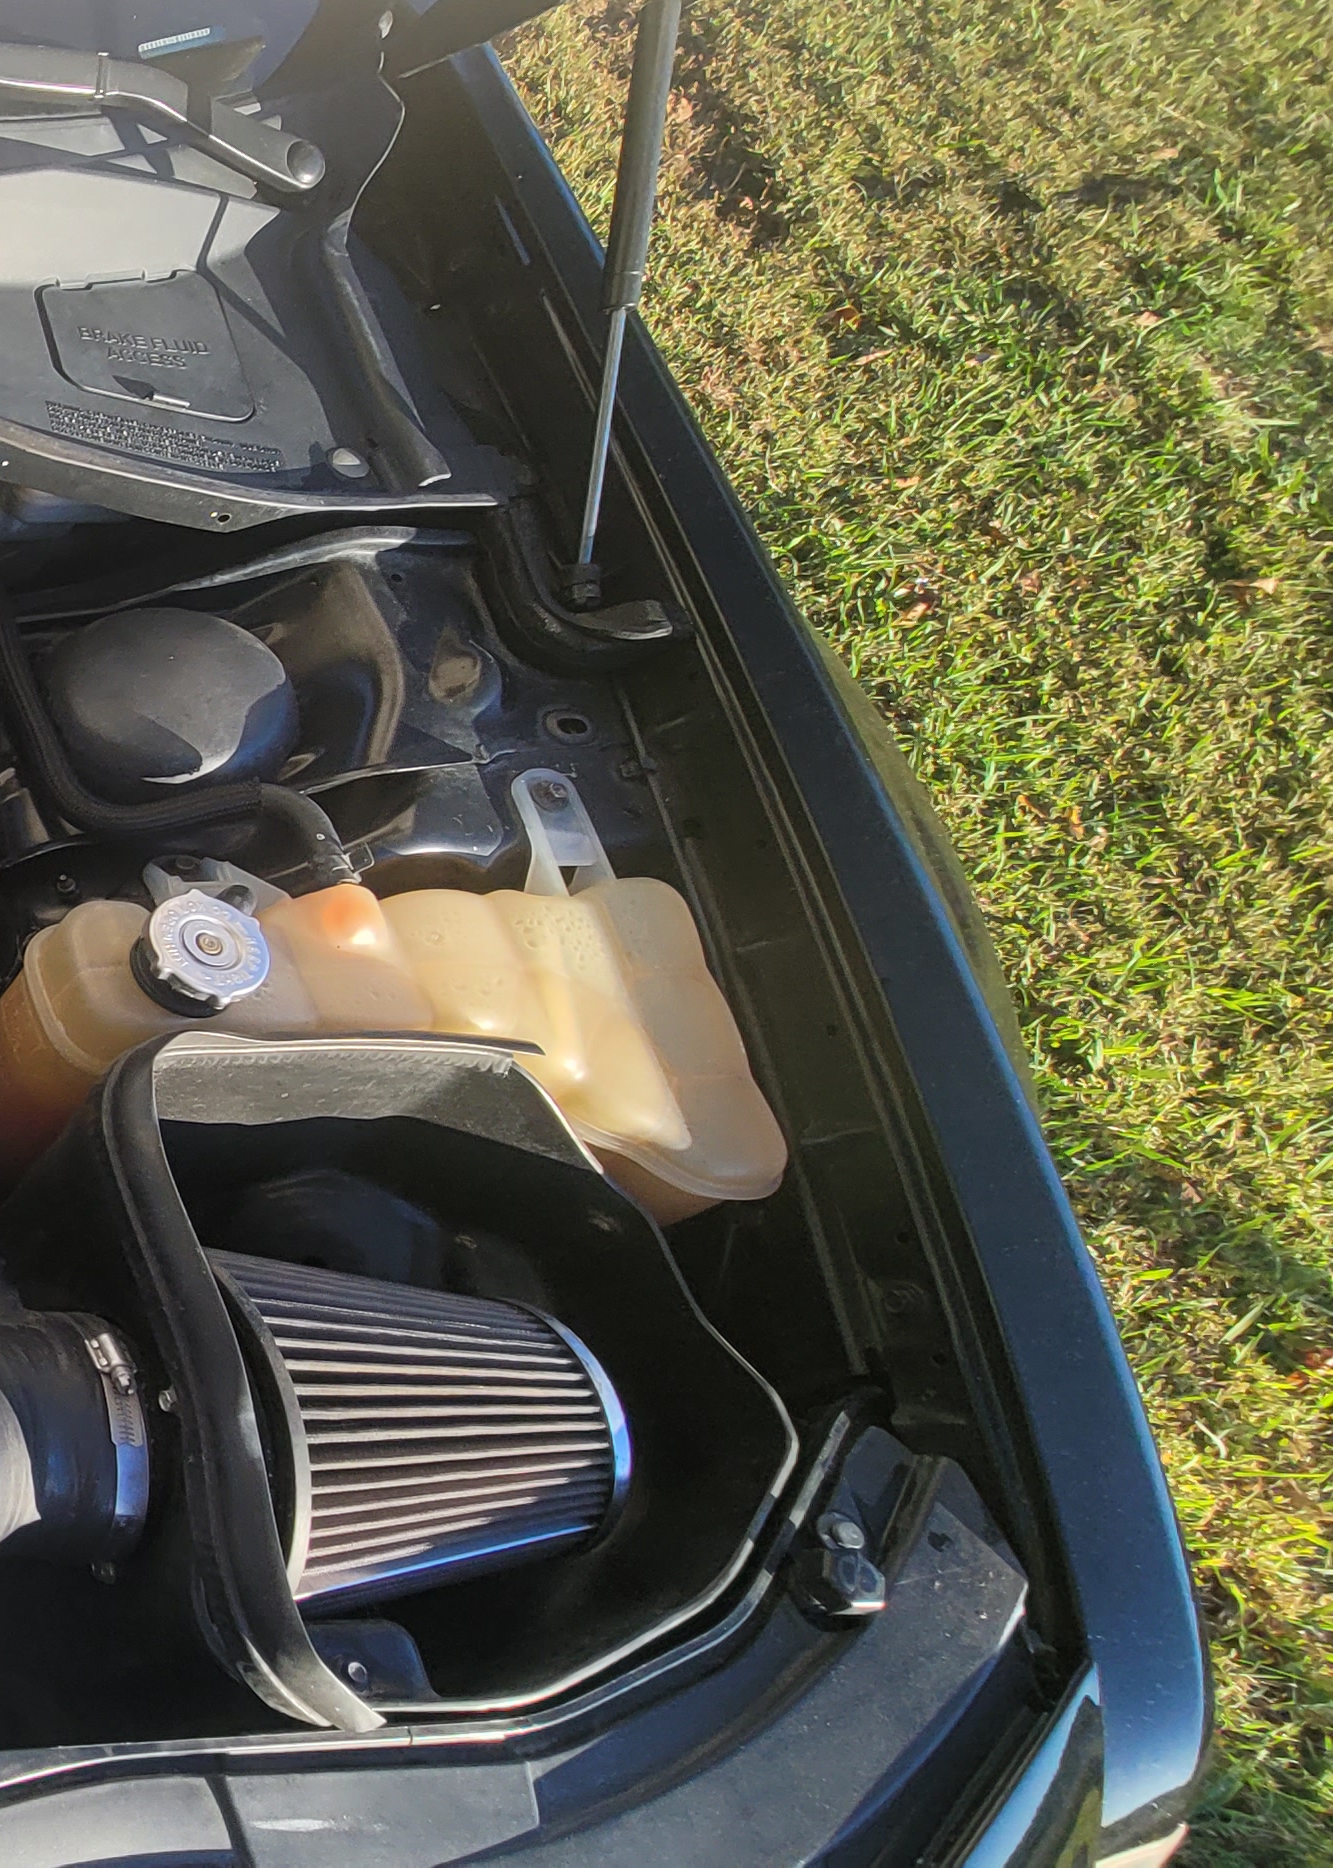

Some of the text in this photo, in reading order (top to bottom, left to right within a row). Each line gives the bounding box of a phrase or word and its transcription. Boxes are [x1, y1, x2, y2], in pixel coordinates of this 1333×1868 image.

[78, 326, 211, 356] BRAKE FLUID
[106, 347, 188, 370] ACCESS
